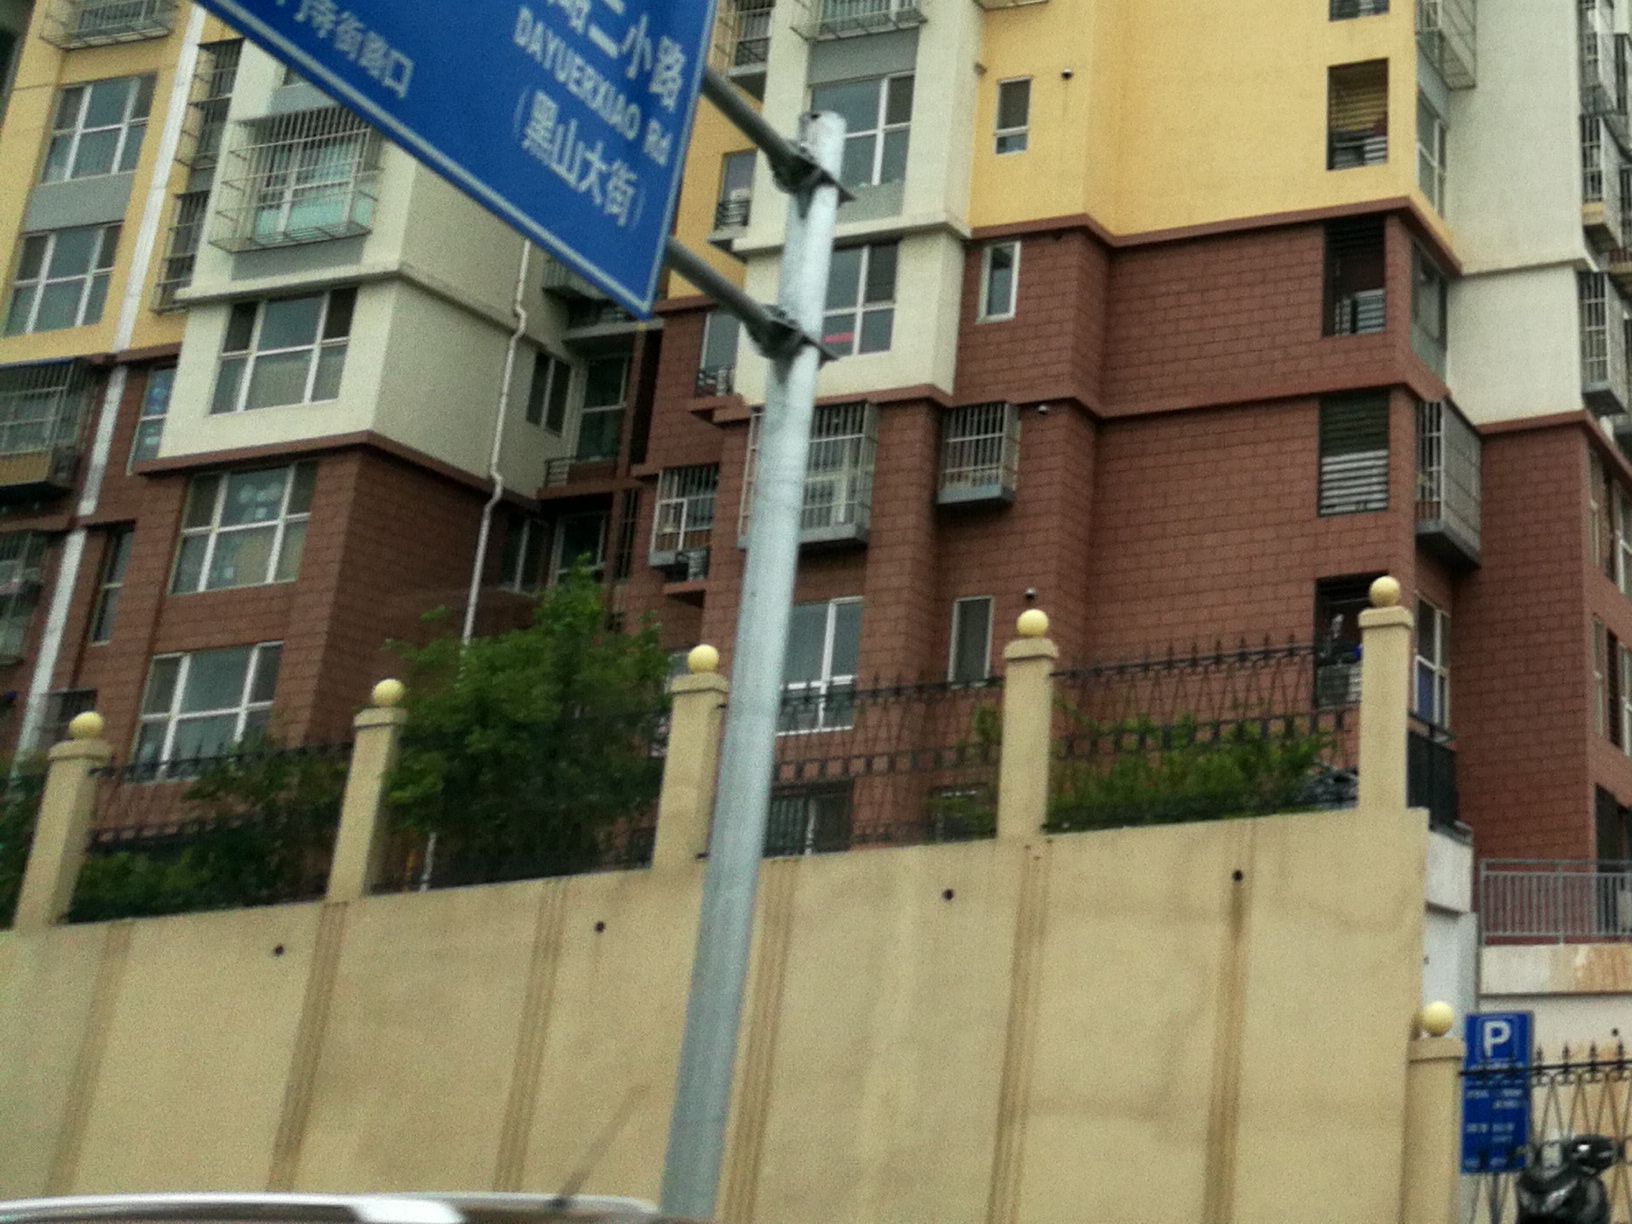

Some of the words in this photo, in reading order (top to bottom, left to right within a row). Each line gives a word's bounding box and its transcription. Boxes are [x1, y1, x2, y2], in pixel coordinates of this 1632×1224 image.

[513, 5, 641, 142] DAYUERXIAO
[643, 119, 673, 167] Rd
[1483, 1019, 1512, 1058] P
